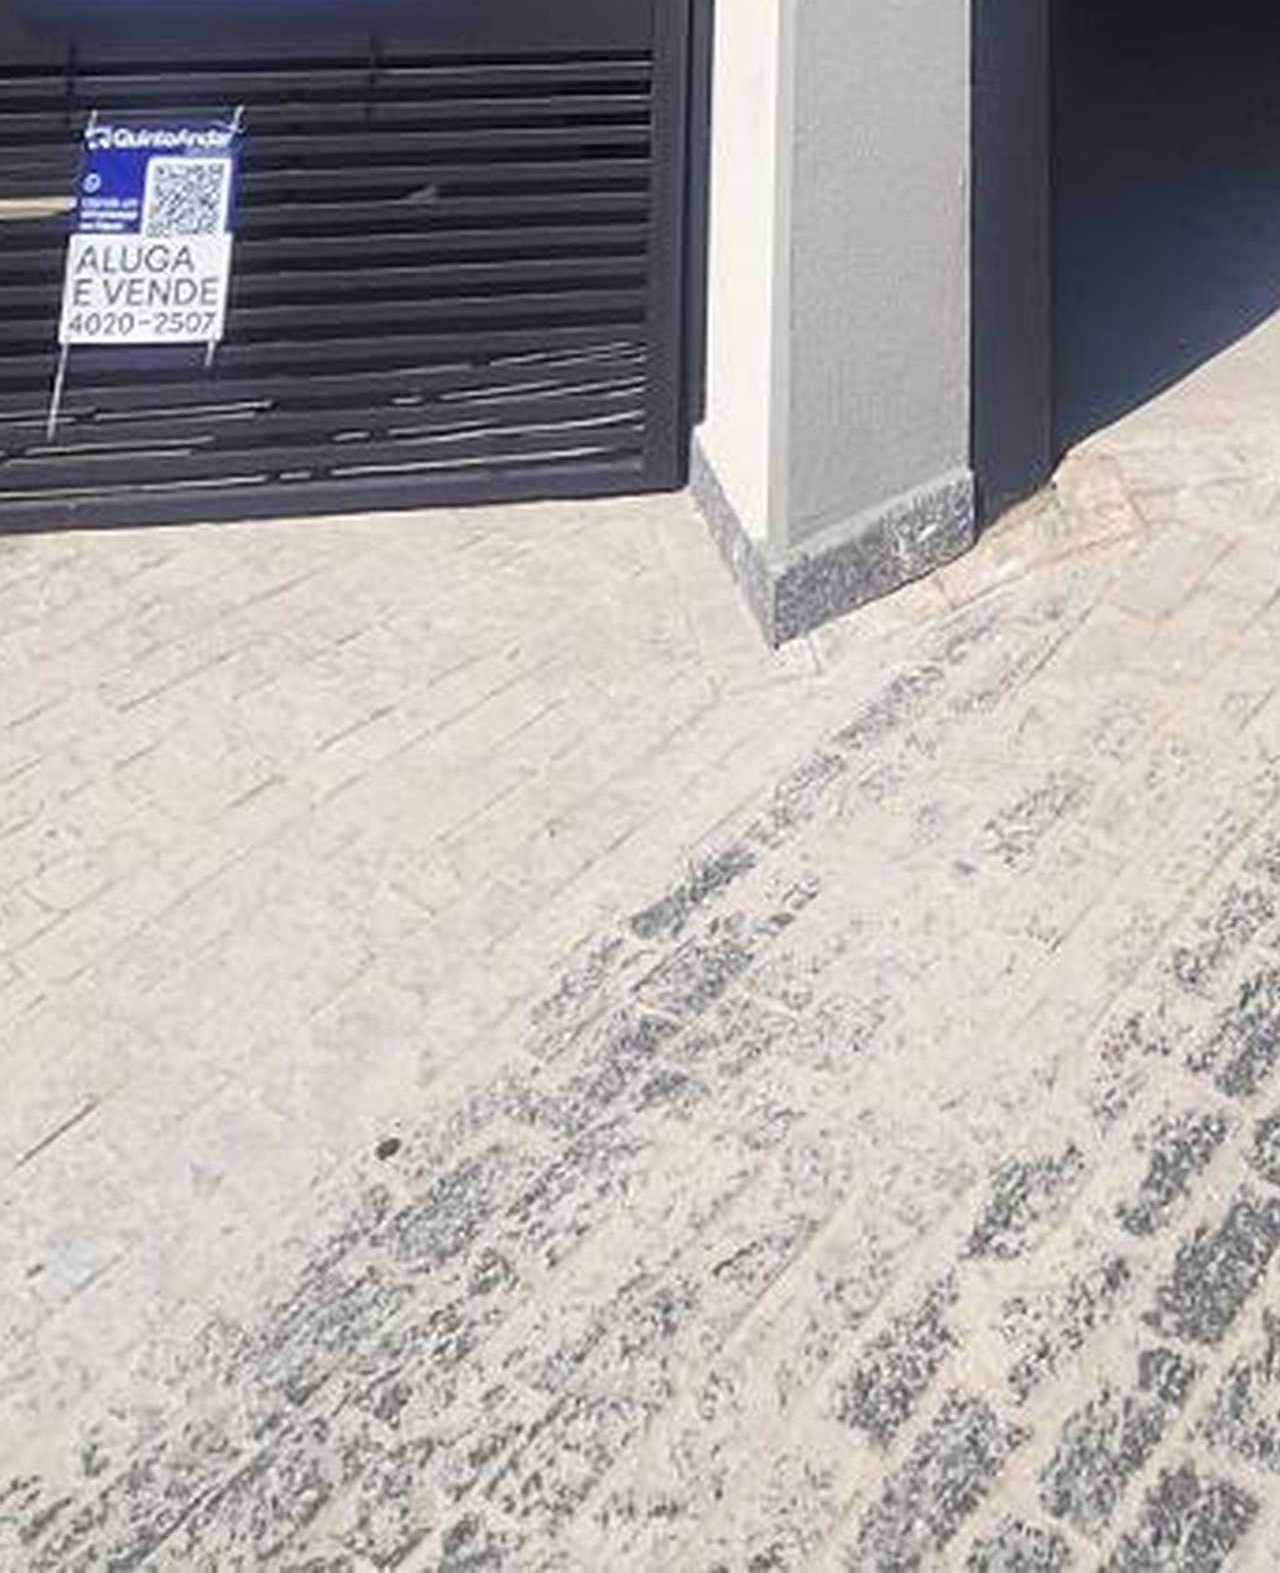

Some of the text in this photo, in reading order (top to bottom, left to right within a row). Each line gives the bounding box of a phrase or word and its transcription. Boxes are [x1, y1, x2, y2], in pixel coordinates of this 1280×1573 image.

[75, 245, 195, 273] ALUGA
[73, 277, 218, 306] E VENDE
[68, 311, 217, 336] 4020-2507
